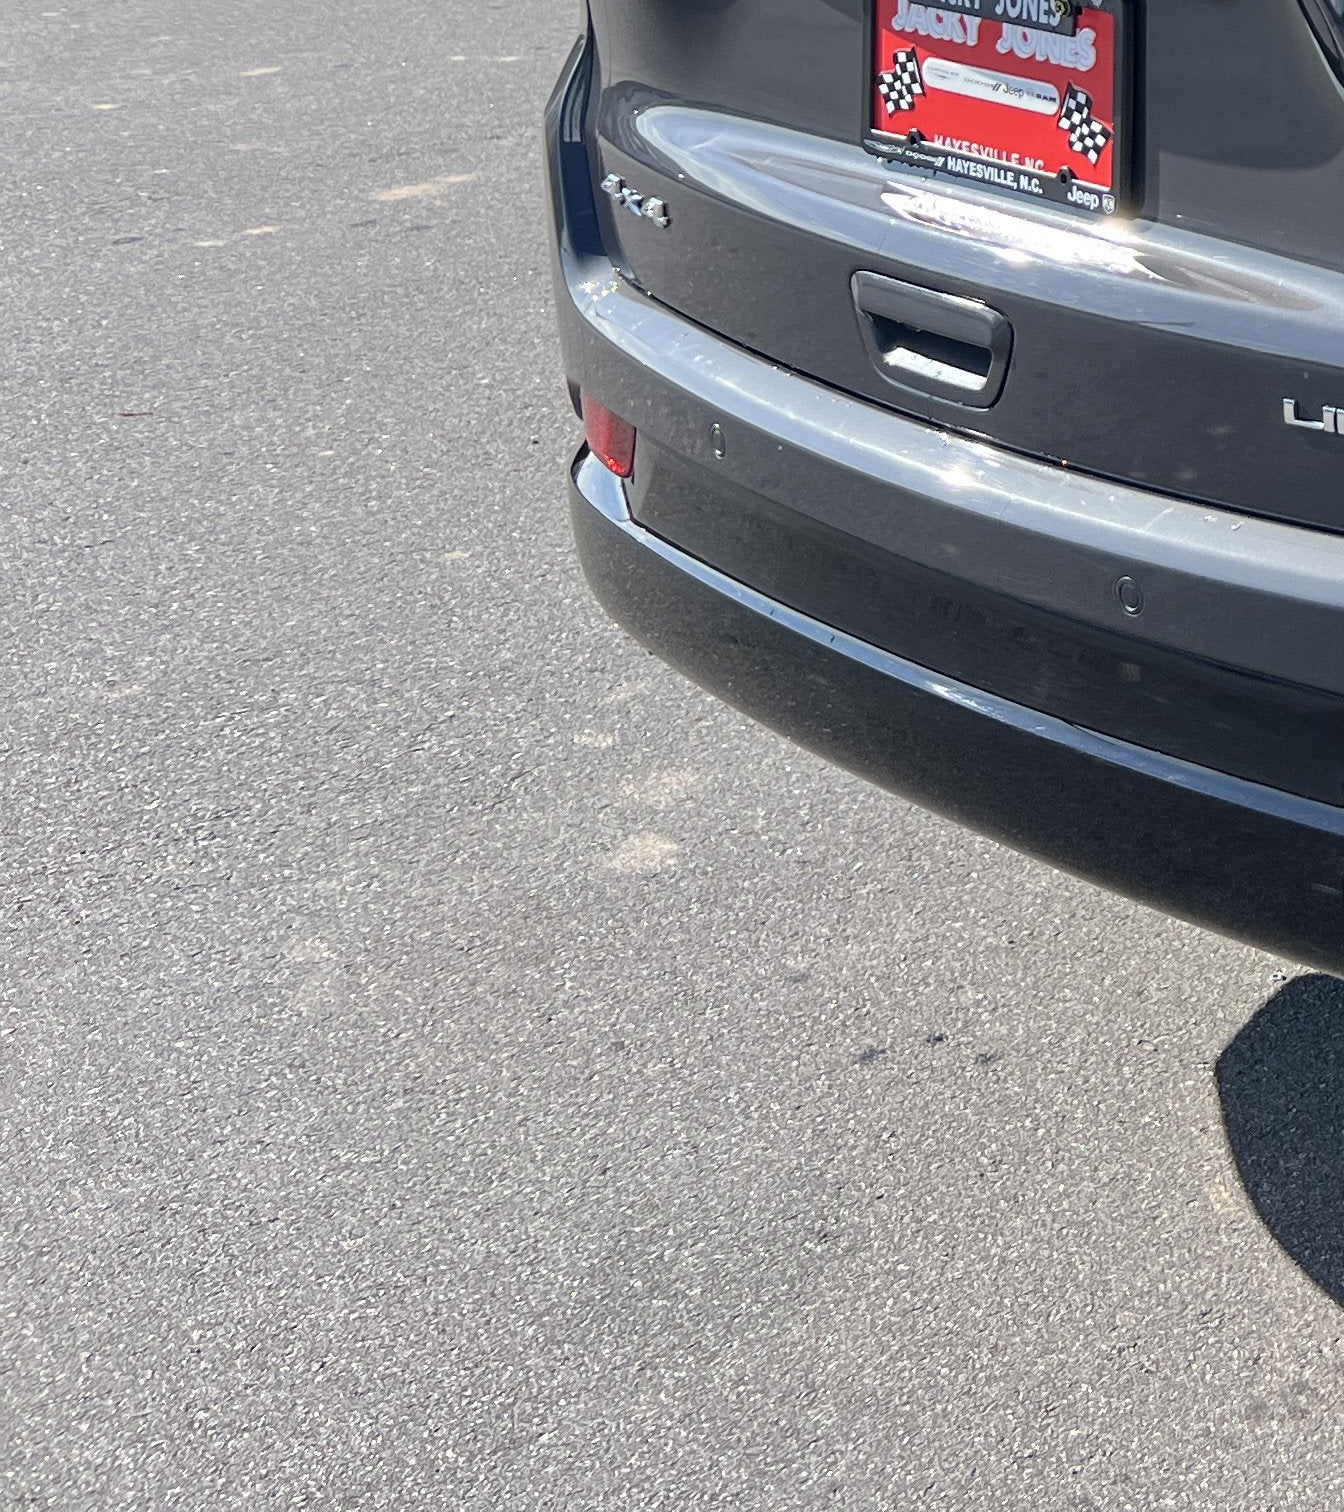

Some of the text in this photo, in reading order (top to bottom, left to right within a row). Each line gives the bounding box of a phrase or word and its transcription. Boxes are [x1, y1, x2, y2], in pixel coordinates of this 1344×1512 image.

[947, 156, 1043, 194] HAYESVILLE, N.C.
[1067, 185, 1099, 210] Jeep
